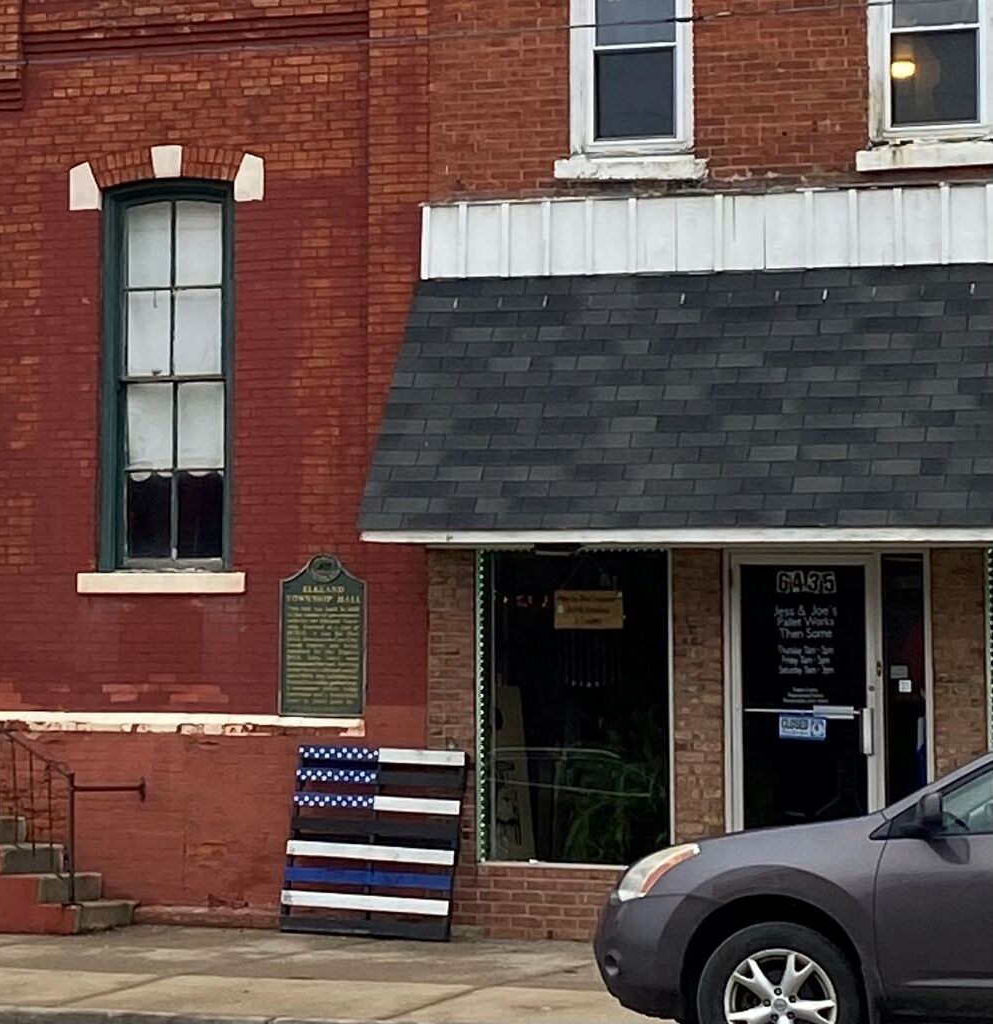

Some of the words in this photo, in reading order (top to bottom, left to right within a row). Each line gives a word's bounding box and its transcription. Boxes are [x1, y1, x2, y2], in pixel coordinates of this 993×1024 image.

[776, 570, 837, 594] 6435
[302, 585, 345, 593] ELKLAND
[286, 594, 333, 603] TOWNSHIP
[337, 595, 361, 604] HALL
